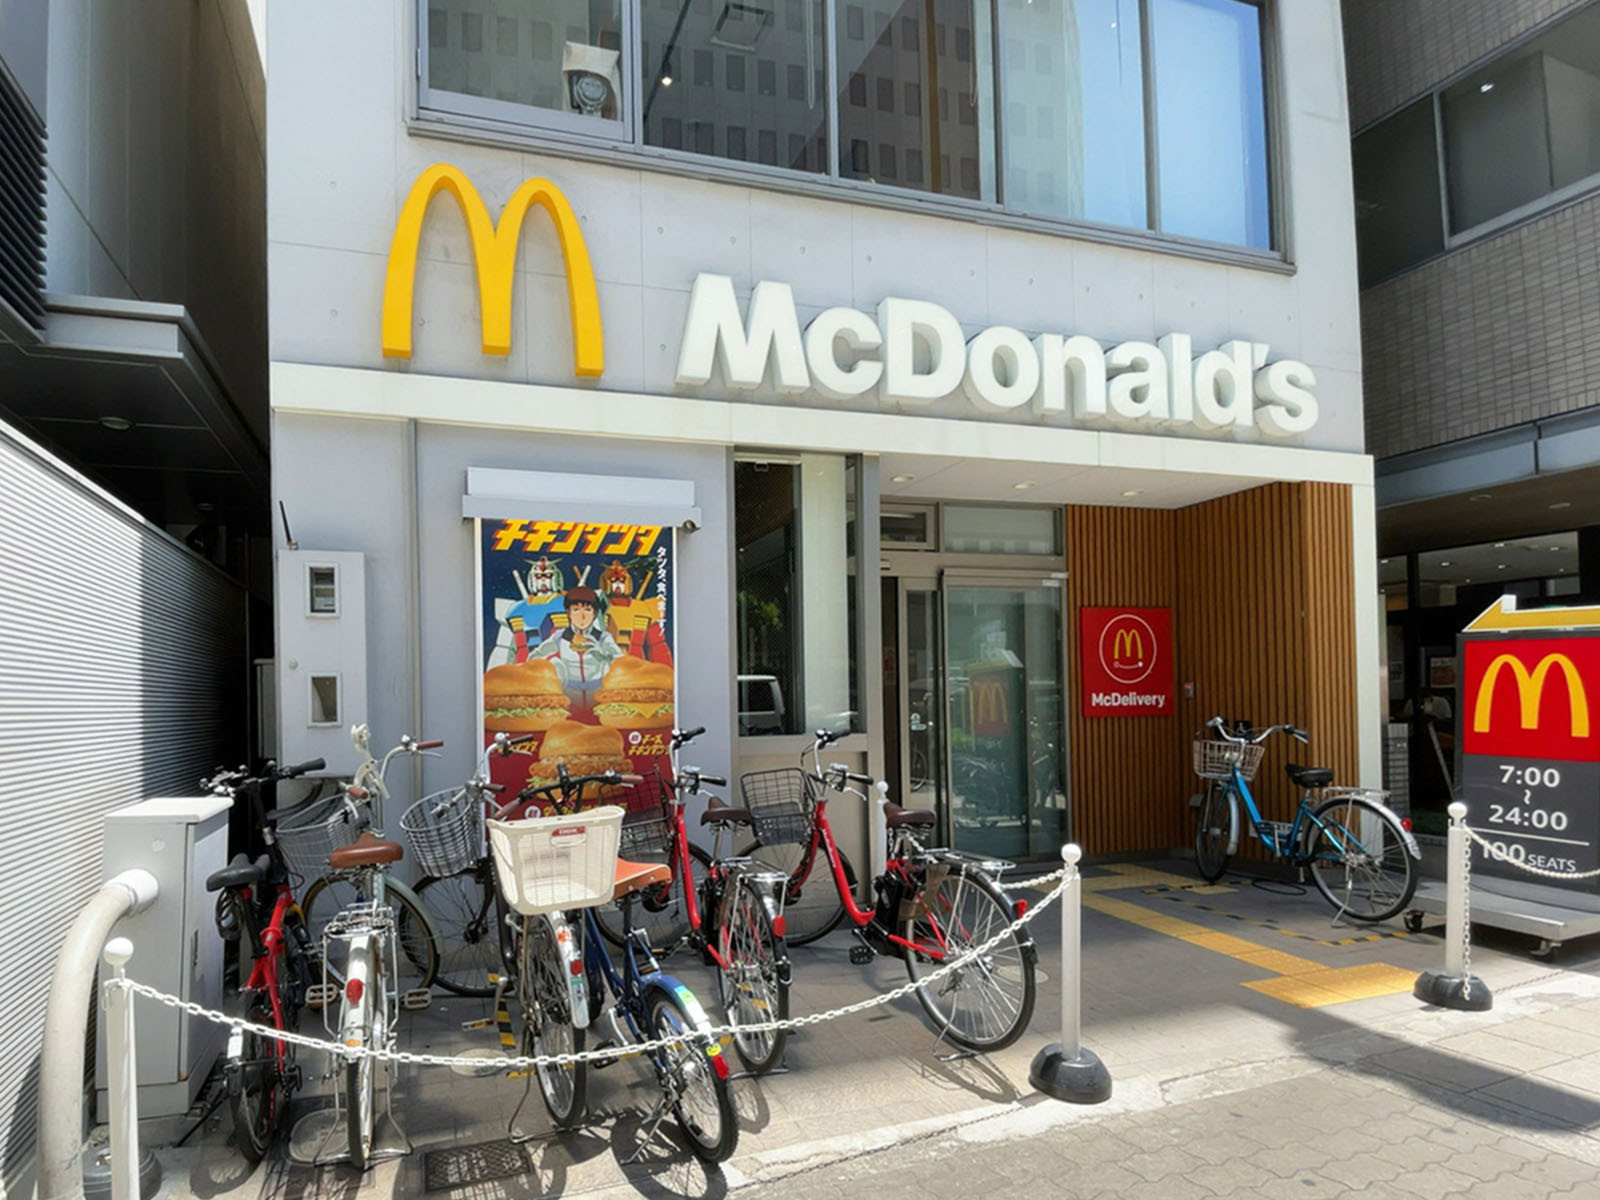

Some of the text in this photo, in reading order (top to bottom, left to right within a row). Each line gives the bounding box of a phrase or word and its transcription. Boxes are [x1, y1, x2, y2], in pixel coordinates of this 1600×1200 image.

[674, 272, 1321, 438] McDonald's
[1091, 691, 1166, 709] McDelivery
[1499, 764, 1561, 788] 7:00
[1488, 804, 1568, 831] 24:00
[1482, 840, 1577, 873] 100 SEATS
